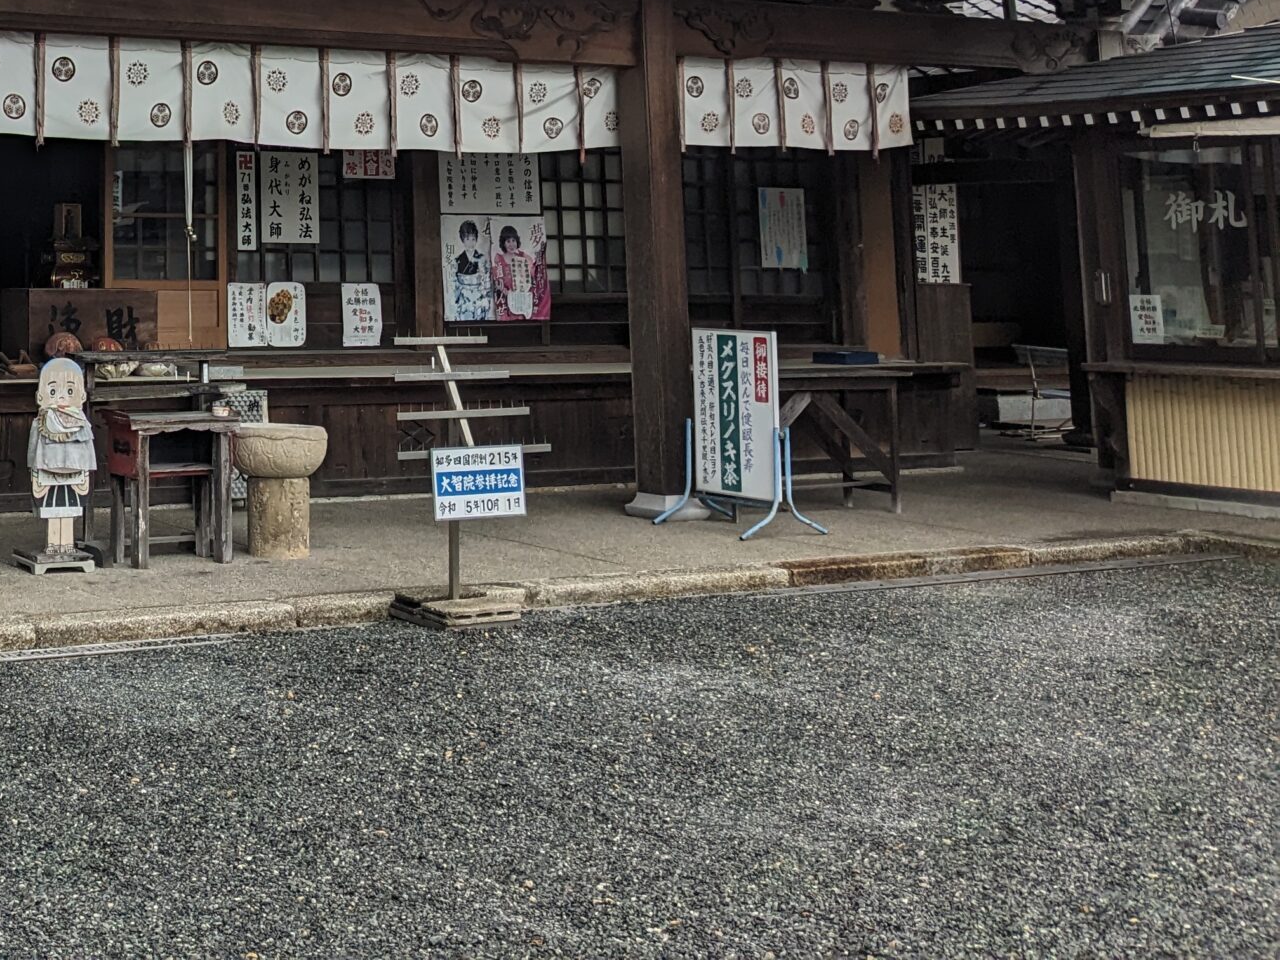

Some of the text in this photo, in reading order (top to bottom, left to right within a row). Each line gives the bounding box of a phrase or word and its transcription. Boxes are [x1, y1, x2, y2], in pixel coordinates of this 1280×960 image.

[268, 155, 283, 240] 身代大師
[298, 157, 313, 239] めがね弘法
[1163, 190, 1248, 233] 御札
[755, 343, 768, 399] 御接待
[720, 340, 739, 487] メクスリノキ茶
[439, 501, 456, 516] 令和
[440, 473, 518, 493] 大智院参拝記念
